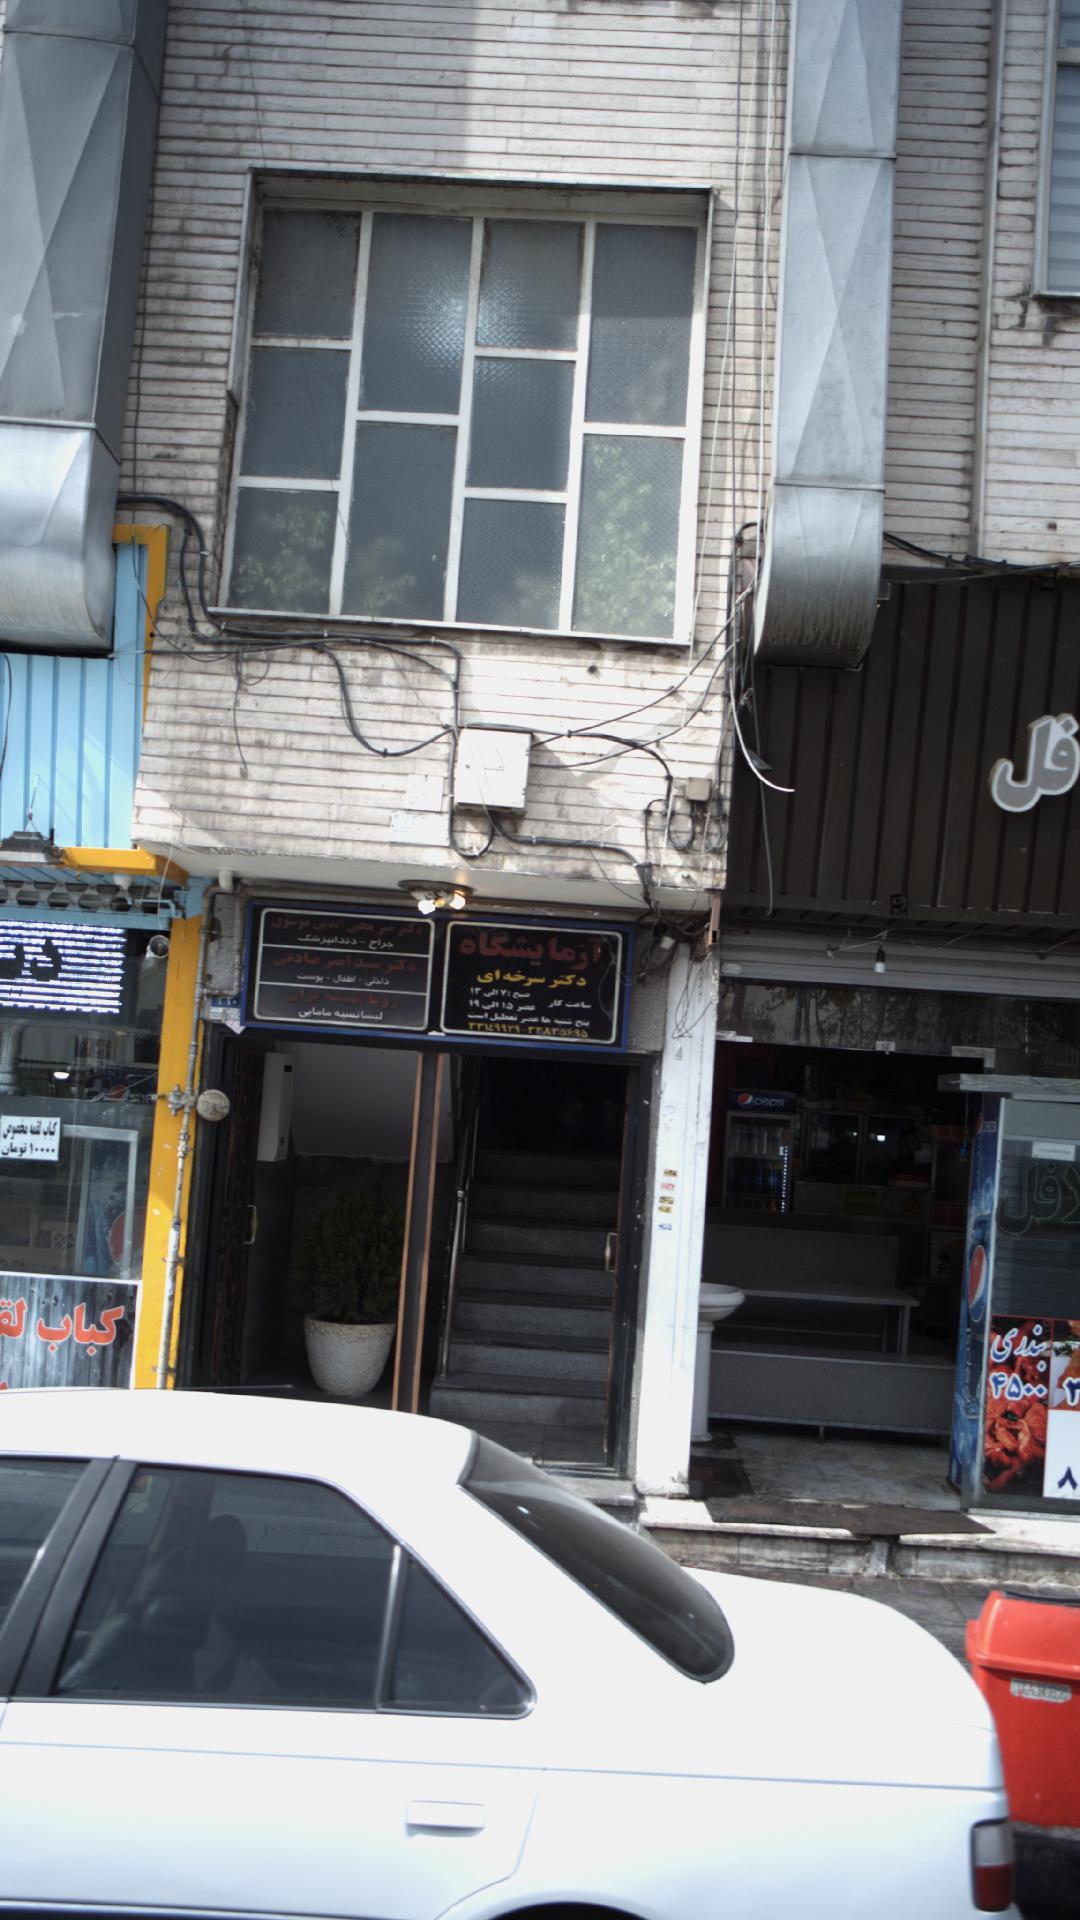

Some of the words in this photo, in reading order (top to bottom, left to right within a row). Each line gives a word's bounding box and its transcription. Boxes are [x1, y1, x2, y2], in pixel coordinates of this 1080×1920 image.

[297, 933, 357, 945] دندانپزشک
[368, 938, 394, 949] جراح
[459, 931, 601, 970] آزمایشگاه
[323, 955, 350, 969] امیر
[354, 958, 381, 969] سید
[384, 959, 416, 974] دکتر
[296, 973, 323, 983] پوست
[332, 974, 356, 984] اطفال
[365, 976, 390, 987] داخلی
[549, 974, 587, 988] دکتر
[483, 989, 499, 997] الی
[481, 1001, 499, 1009] الی
[502, 1001, 514, 1010] ۱۵
[549, 999, 563, 1008] کار
[565, 1001, 592, 1009] ساعت
[298, 1006, 332, 1018] مامایی
[334, 1009, 383, 1020] لیسانسیه
[490, 1013, 518, 1021] تعطیل
[575, 1020, 590, 1028] پنج
[2, 1123, 28, 1140] مخصوص
[30, 1120, 42, 1135] لقمه
[43, 1120, 58, 1140] کباب
[1, 1141, 27, 1156] تومان
[30, 1143, 55, 1154] ۱۰۰۰۰
[36, 1302, 125, 1357] کباب
[990, 1324, 1047, 1372] بندری
[989, 1371, 1048, 1401] ۴۵۰۰
